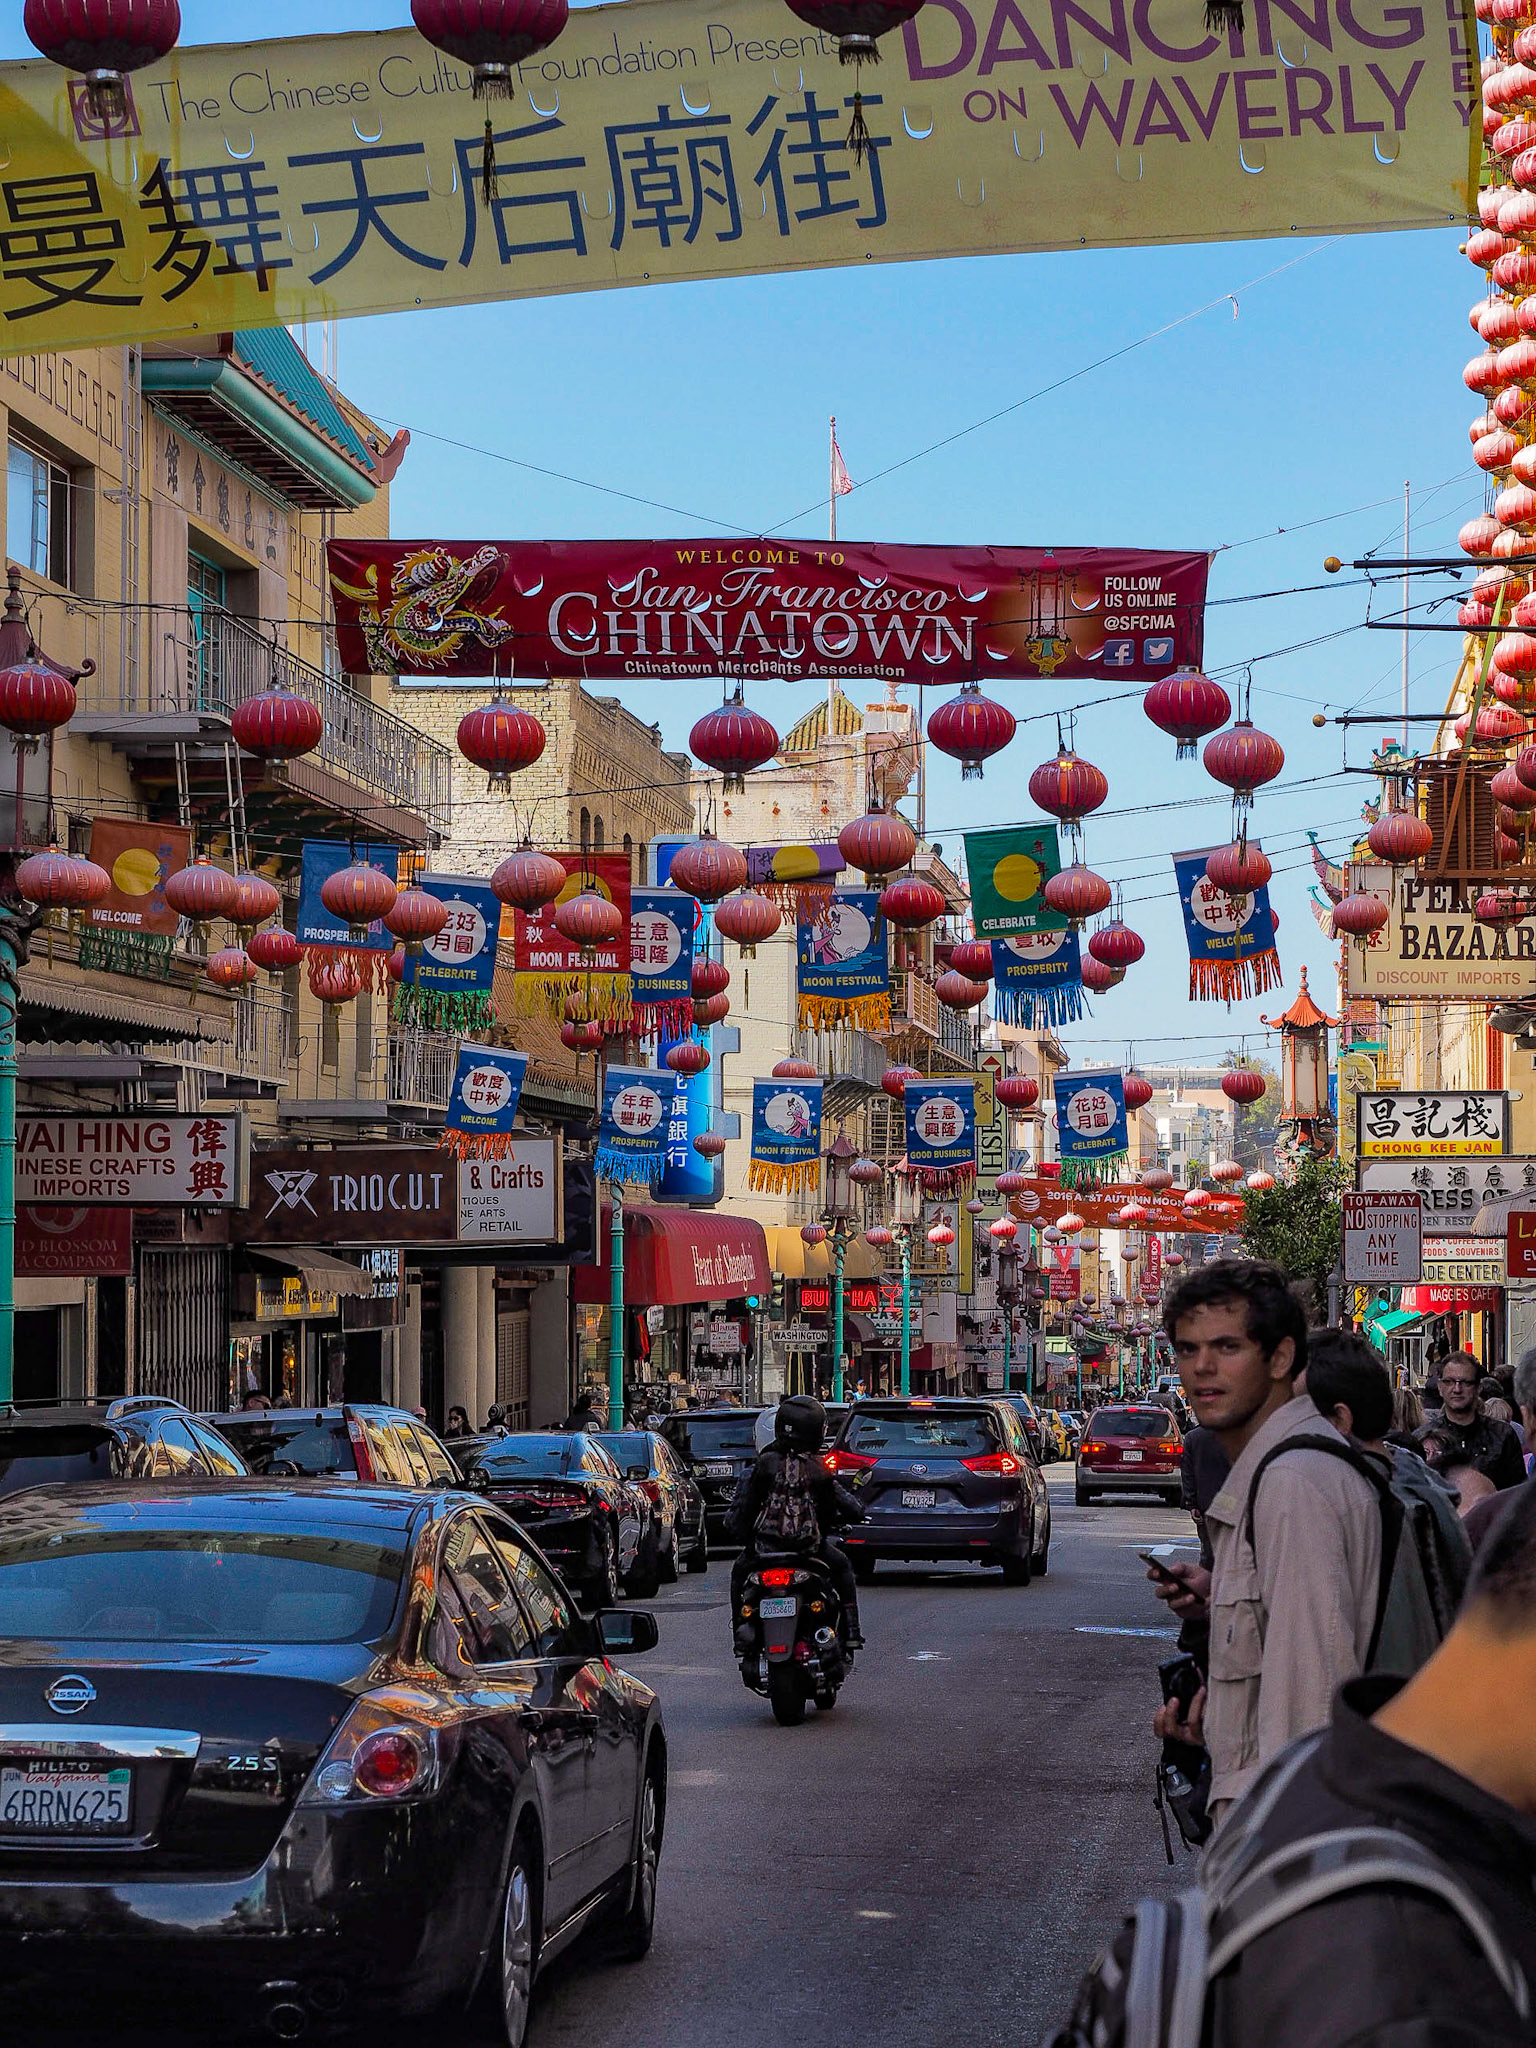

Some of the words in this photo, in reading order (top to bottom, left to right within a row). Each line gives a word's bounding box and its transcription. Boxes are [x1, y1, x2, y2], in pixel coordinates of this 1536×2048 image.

[903, 0, 1425, 82] DANCING
[148, 80, 221, 122] The
[229, 70, 371, 117] Chinese
[516, 33, 697, 84] Foundation
[706, 24, 843, 68] Presents
[963, 87, 1028, 124] ON
[1048, 59, 1426, 149] WAVERLY
[675, 549, 799, 566] WELCOME
[815, 551, 845, 567] TO
[610, 567, 697, 609] San
[714, 567, 956, 612] Francisco
[1104, 576, 1162, 592] FOLLOW
[1104, 592, 1125, 608] US
[1127, 592, 1177, 609] ONLINE
[547, 591, 978, 662] CHINATOWN
[1104, 614, 1175, 632] @SFCMA
[624, 660, 712, 675] Chinatown
[718, 659, 802, 676] Merchants
[807, 662, 905, 678] Association
[92, 908, 143, 925] WELCOME
[981, 915, 1037, 931] CELEBRATE
[1399, 925, 1536, 961] BAZAAR
[530, 952, 563, 968] MOON
[418, 965, 478, 981] CELEBRATE
[1006, 962, 1069, 977] PROSPERITY
[1376, 970, 1449, 985] DISCOUNT
[1457, 972, 1521, 985] IMPORTS
[638, 979, 688, 990] BUSINESS
[803, 976, 834, 988] MOON
[836, 974, 884, 987] FESTIVAL
[469, 1089, 502, 1107] 中秋
[621, 1093, 654, 1110] 年年
[460, 1114, 499, 1127] WELCOME
[77, 1121, 171, 1154] HING
[610, 1135, 660, 1149] PROSPERITY
[1071, 1137, 1117, 1151] CELEBRATE
[755, 1146, 779, 1155] MOON
[780, 1145, 816, 1155] FESTIVAL
[910, 1150, 932, 1160] GOOD
[933, 1149, 972, 1160] BUSINESS
[1372, 1143, 1422, 1154] CHONG
[1430, 1143, 1457, 1153] KEE
[1463, 1142, 1493, 1153] JAN
[89, 1157, 176, 1176] CRAFTS
[470, 1165, 483, 1190] &
[491, 1163, 544, 1189] Crafts
[33, 1179, 131, 1196] IMPORTS
[329, 1173, 384, 1212] TRIO
[1046, 1191, 1073, 1201] 2016
[1104, 1193, 1152, 1206] AUTUMN
[1152, 1197, 1186, 1208] MOON
[1348, 1195, 1417, 1207] TOW-AWAY
[479, 1208, 506, 1218] ARTS
[1345, 1208, 1365, 1229] NO
[1367, 1213, 1418, 1229] STOPPING
[479, 1220, 523, 1233] RETAIL
[39, 1239, 118, 1252] BLOSSOM
[1367, 1233, 1398, 1249] ANY
[1365, 1252, 1399, 1267] TIME
[1423, 1248, 1447, 1257] FOODS
[1455, 1247, 1500, 1256] SOUVENIRS
[33, 1254, 119, 1269] COMPANY
[691, 1245, 716, 1286] Heart
[714, 1244, 726, 1286] of
[722, 1242, 757, 1292] Shanghai
[1448, 1264, 1501, 1282] CENTER
[1430, 1288, 1469, 1302] MAGGIE'S
[773, 1331, 828, 1341] WASHINGTON
[3, 1773, 21, 1782] JUN
[26, 1772, 106, 1788] California
[3, 1790, 123, 1823] 6RRN625
